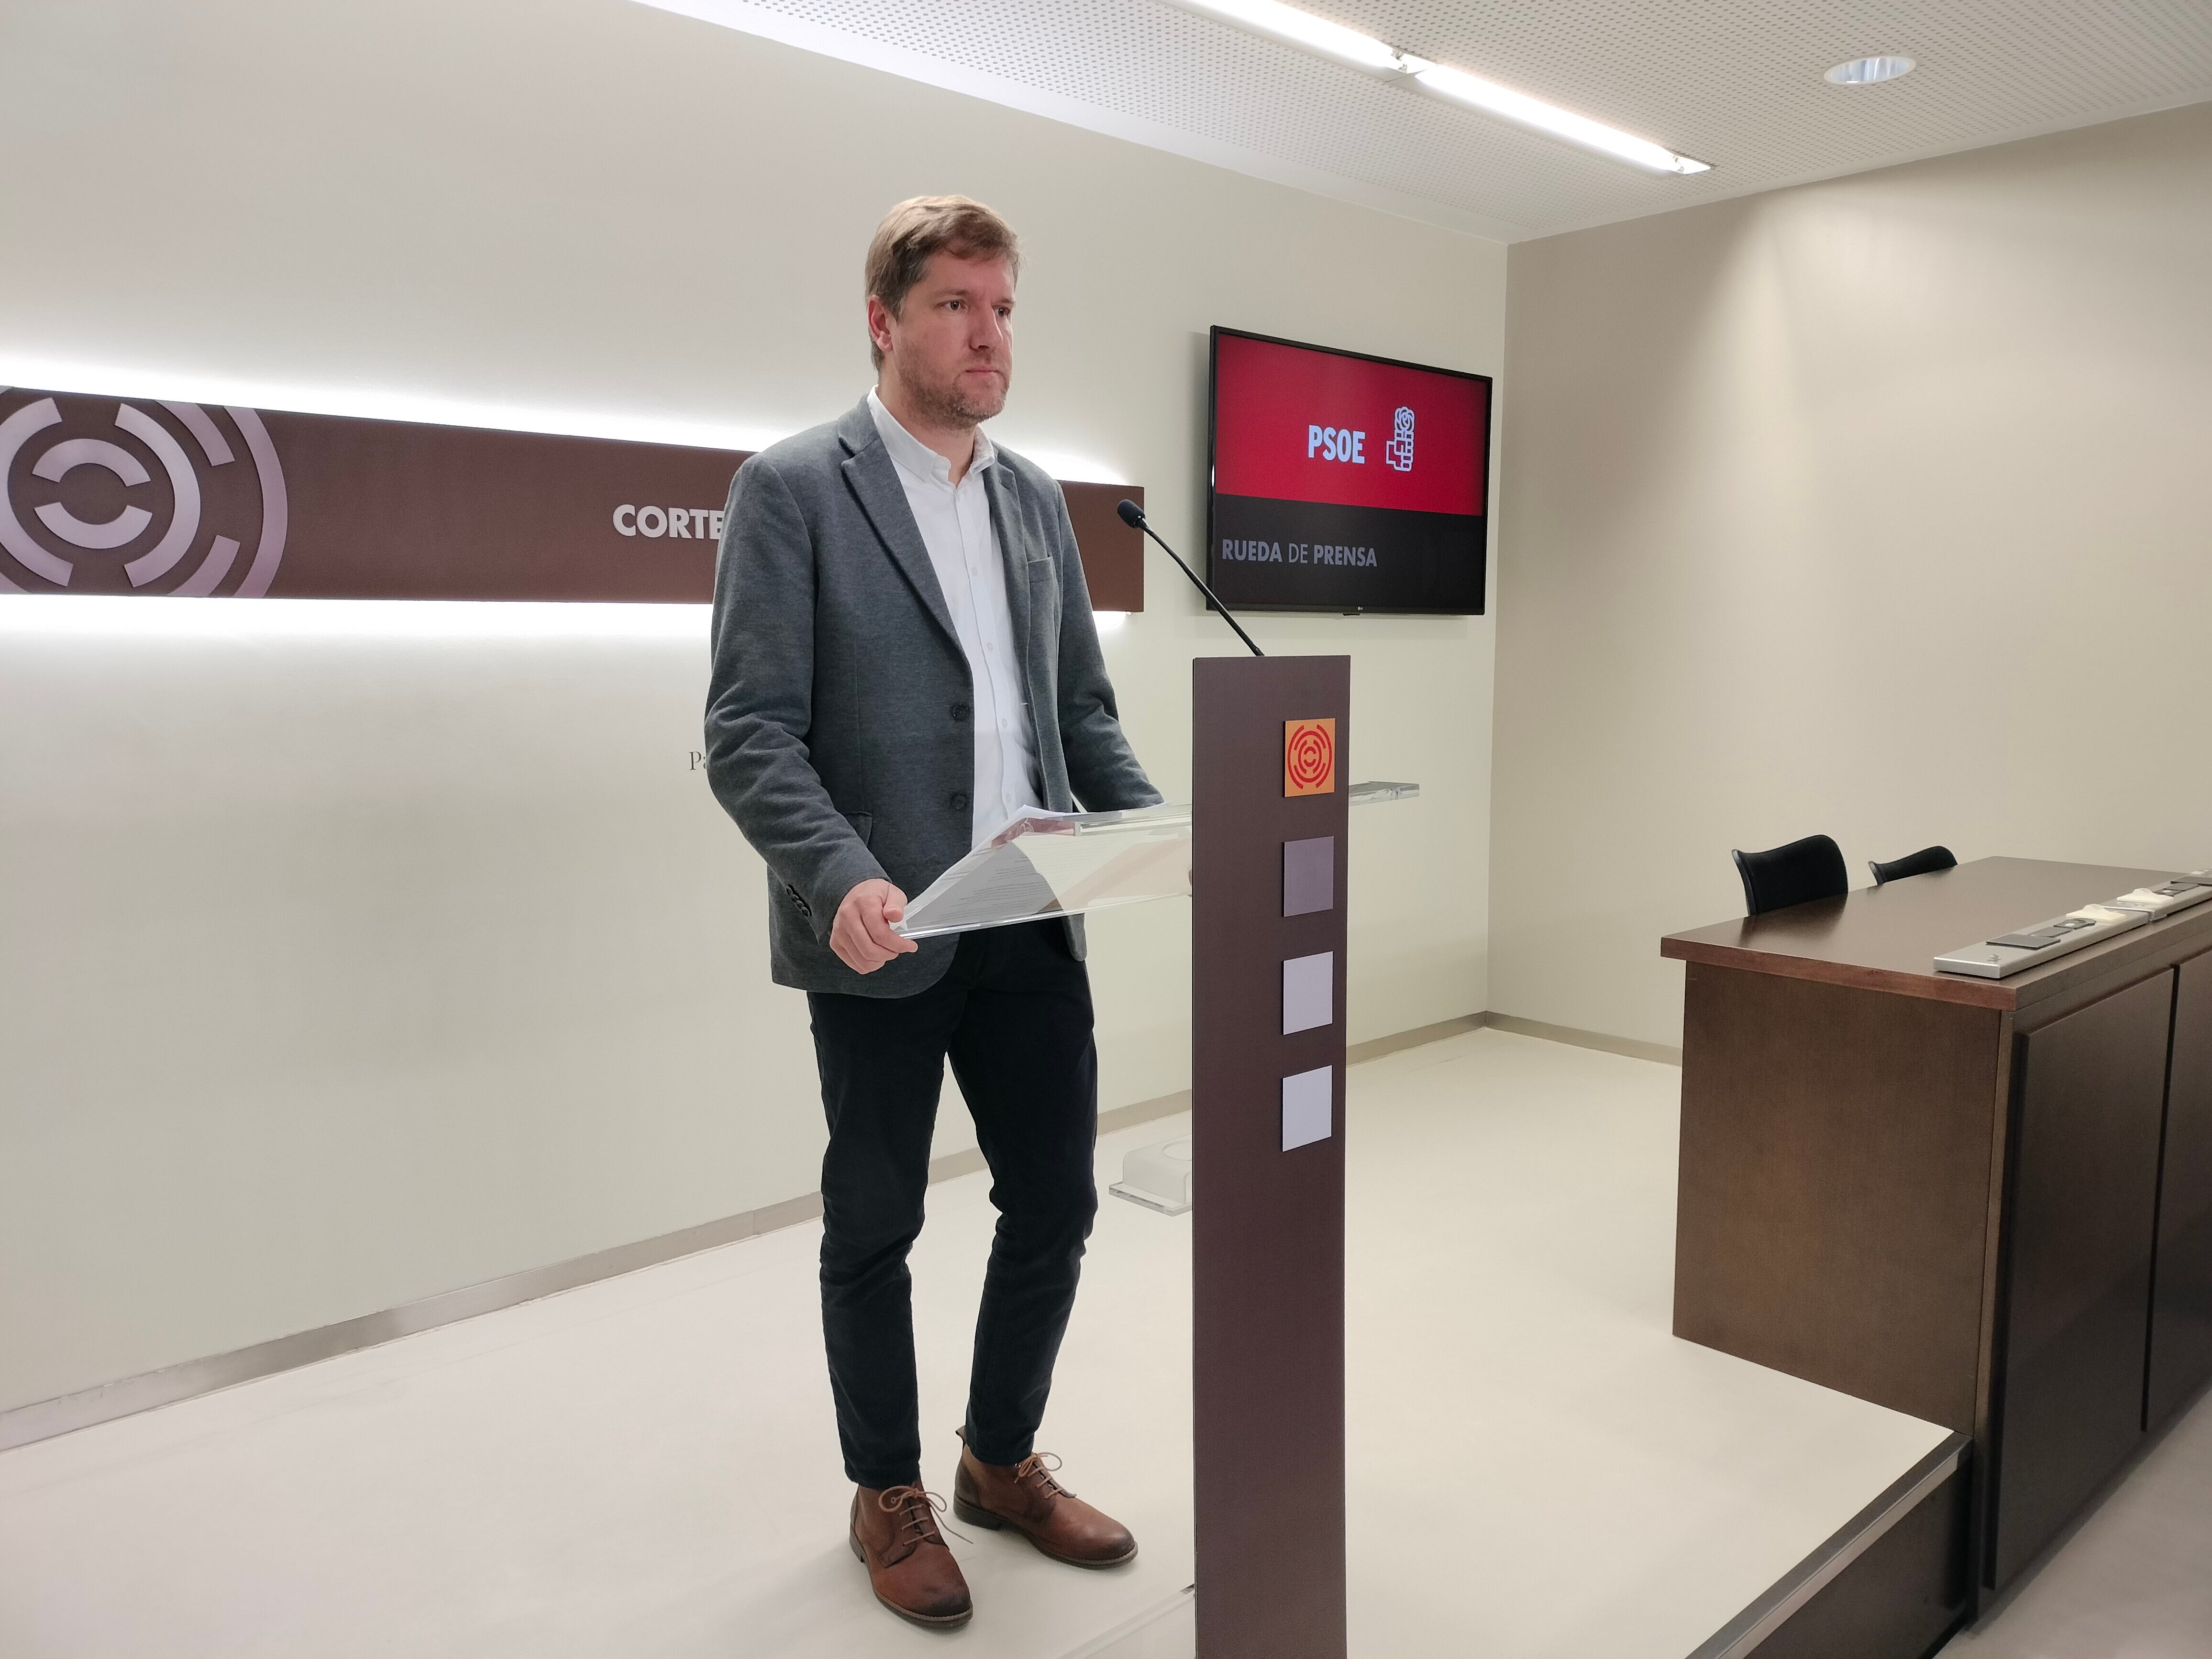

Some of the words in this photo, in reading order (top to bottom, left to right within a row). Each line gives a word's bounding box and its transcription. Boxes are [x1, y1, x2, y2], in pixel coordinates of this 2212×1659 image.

[1308, 424, 1365, 464] PSOE
[1222, 539, 1283, 563] RUEDA
[1289, 543, 1308, 564] DE
[1314, 544, 1378, 567] PRENSA
